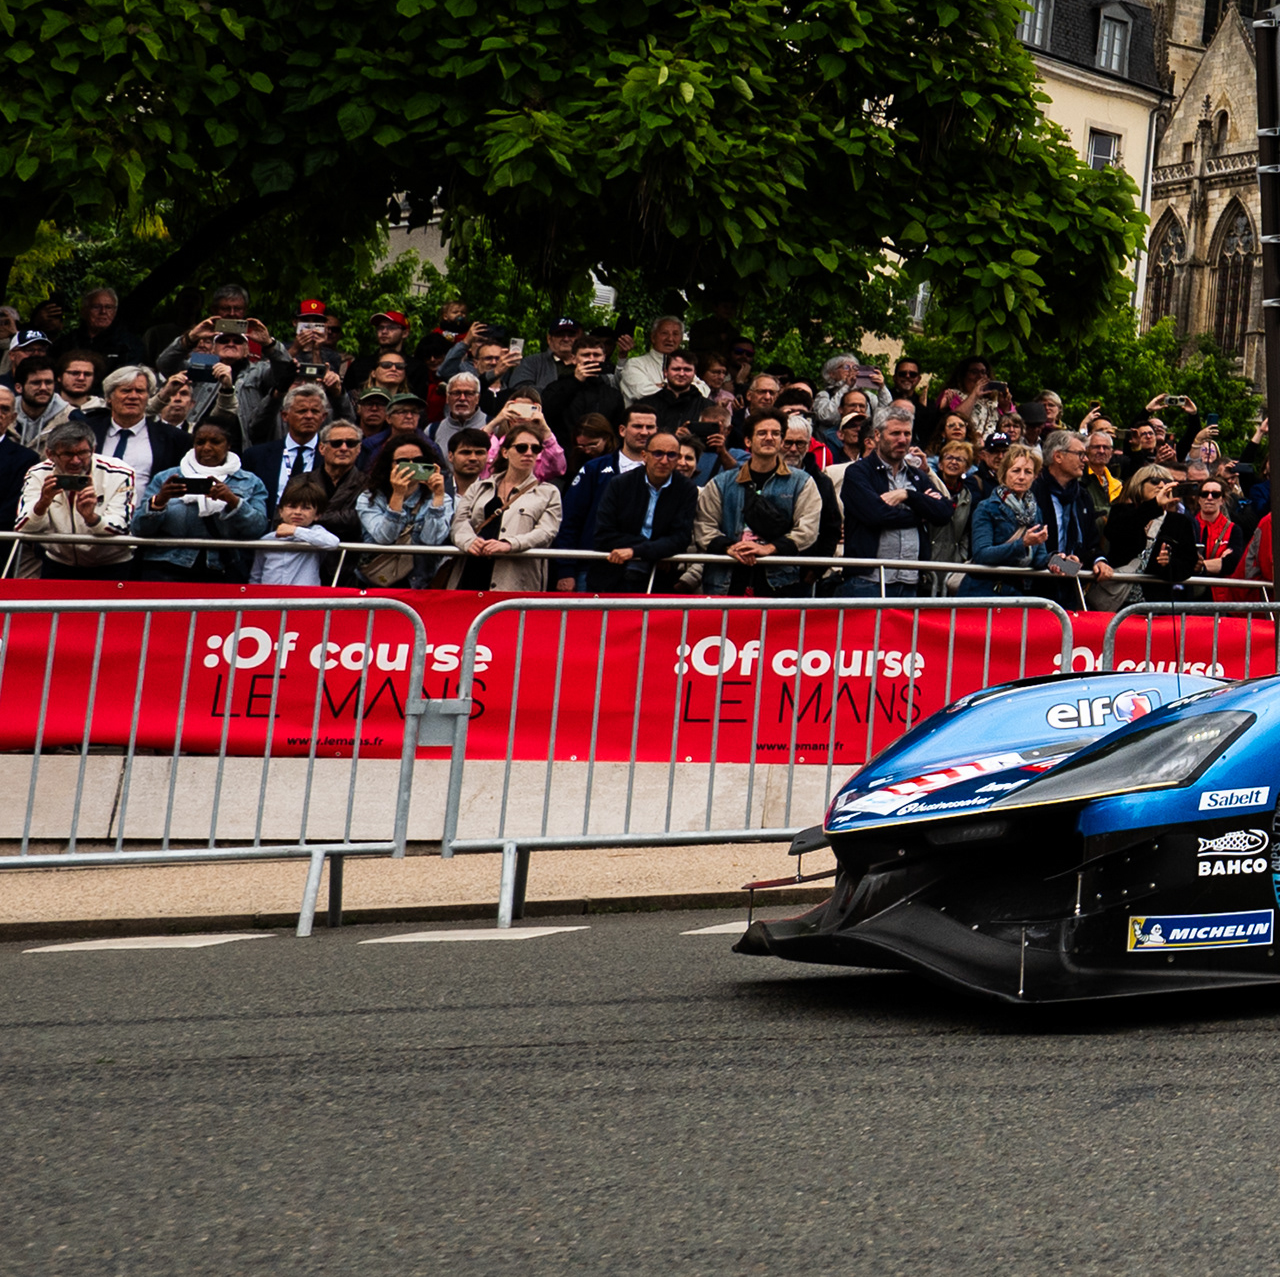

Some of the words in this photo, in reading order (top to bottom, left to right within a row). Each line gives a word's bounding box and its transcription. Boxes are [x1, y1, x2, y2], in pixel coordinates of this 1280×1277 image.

[771, 648, 926, 679] course
[210, 673, 287, 719] LE
[683, 679, 752, 724] LE
[777, 680, 923, 725] MANS
[1046, 695, 1111, 729] elf
[1207, 789, 1263, 808] Sabelt
[1198, 858, 1268, 877] BAHCO
[1168, 922, 1270, 941] MICHELIN
